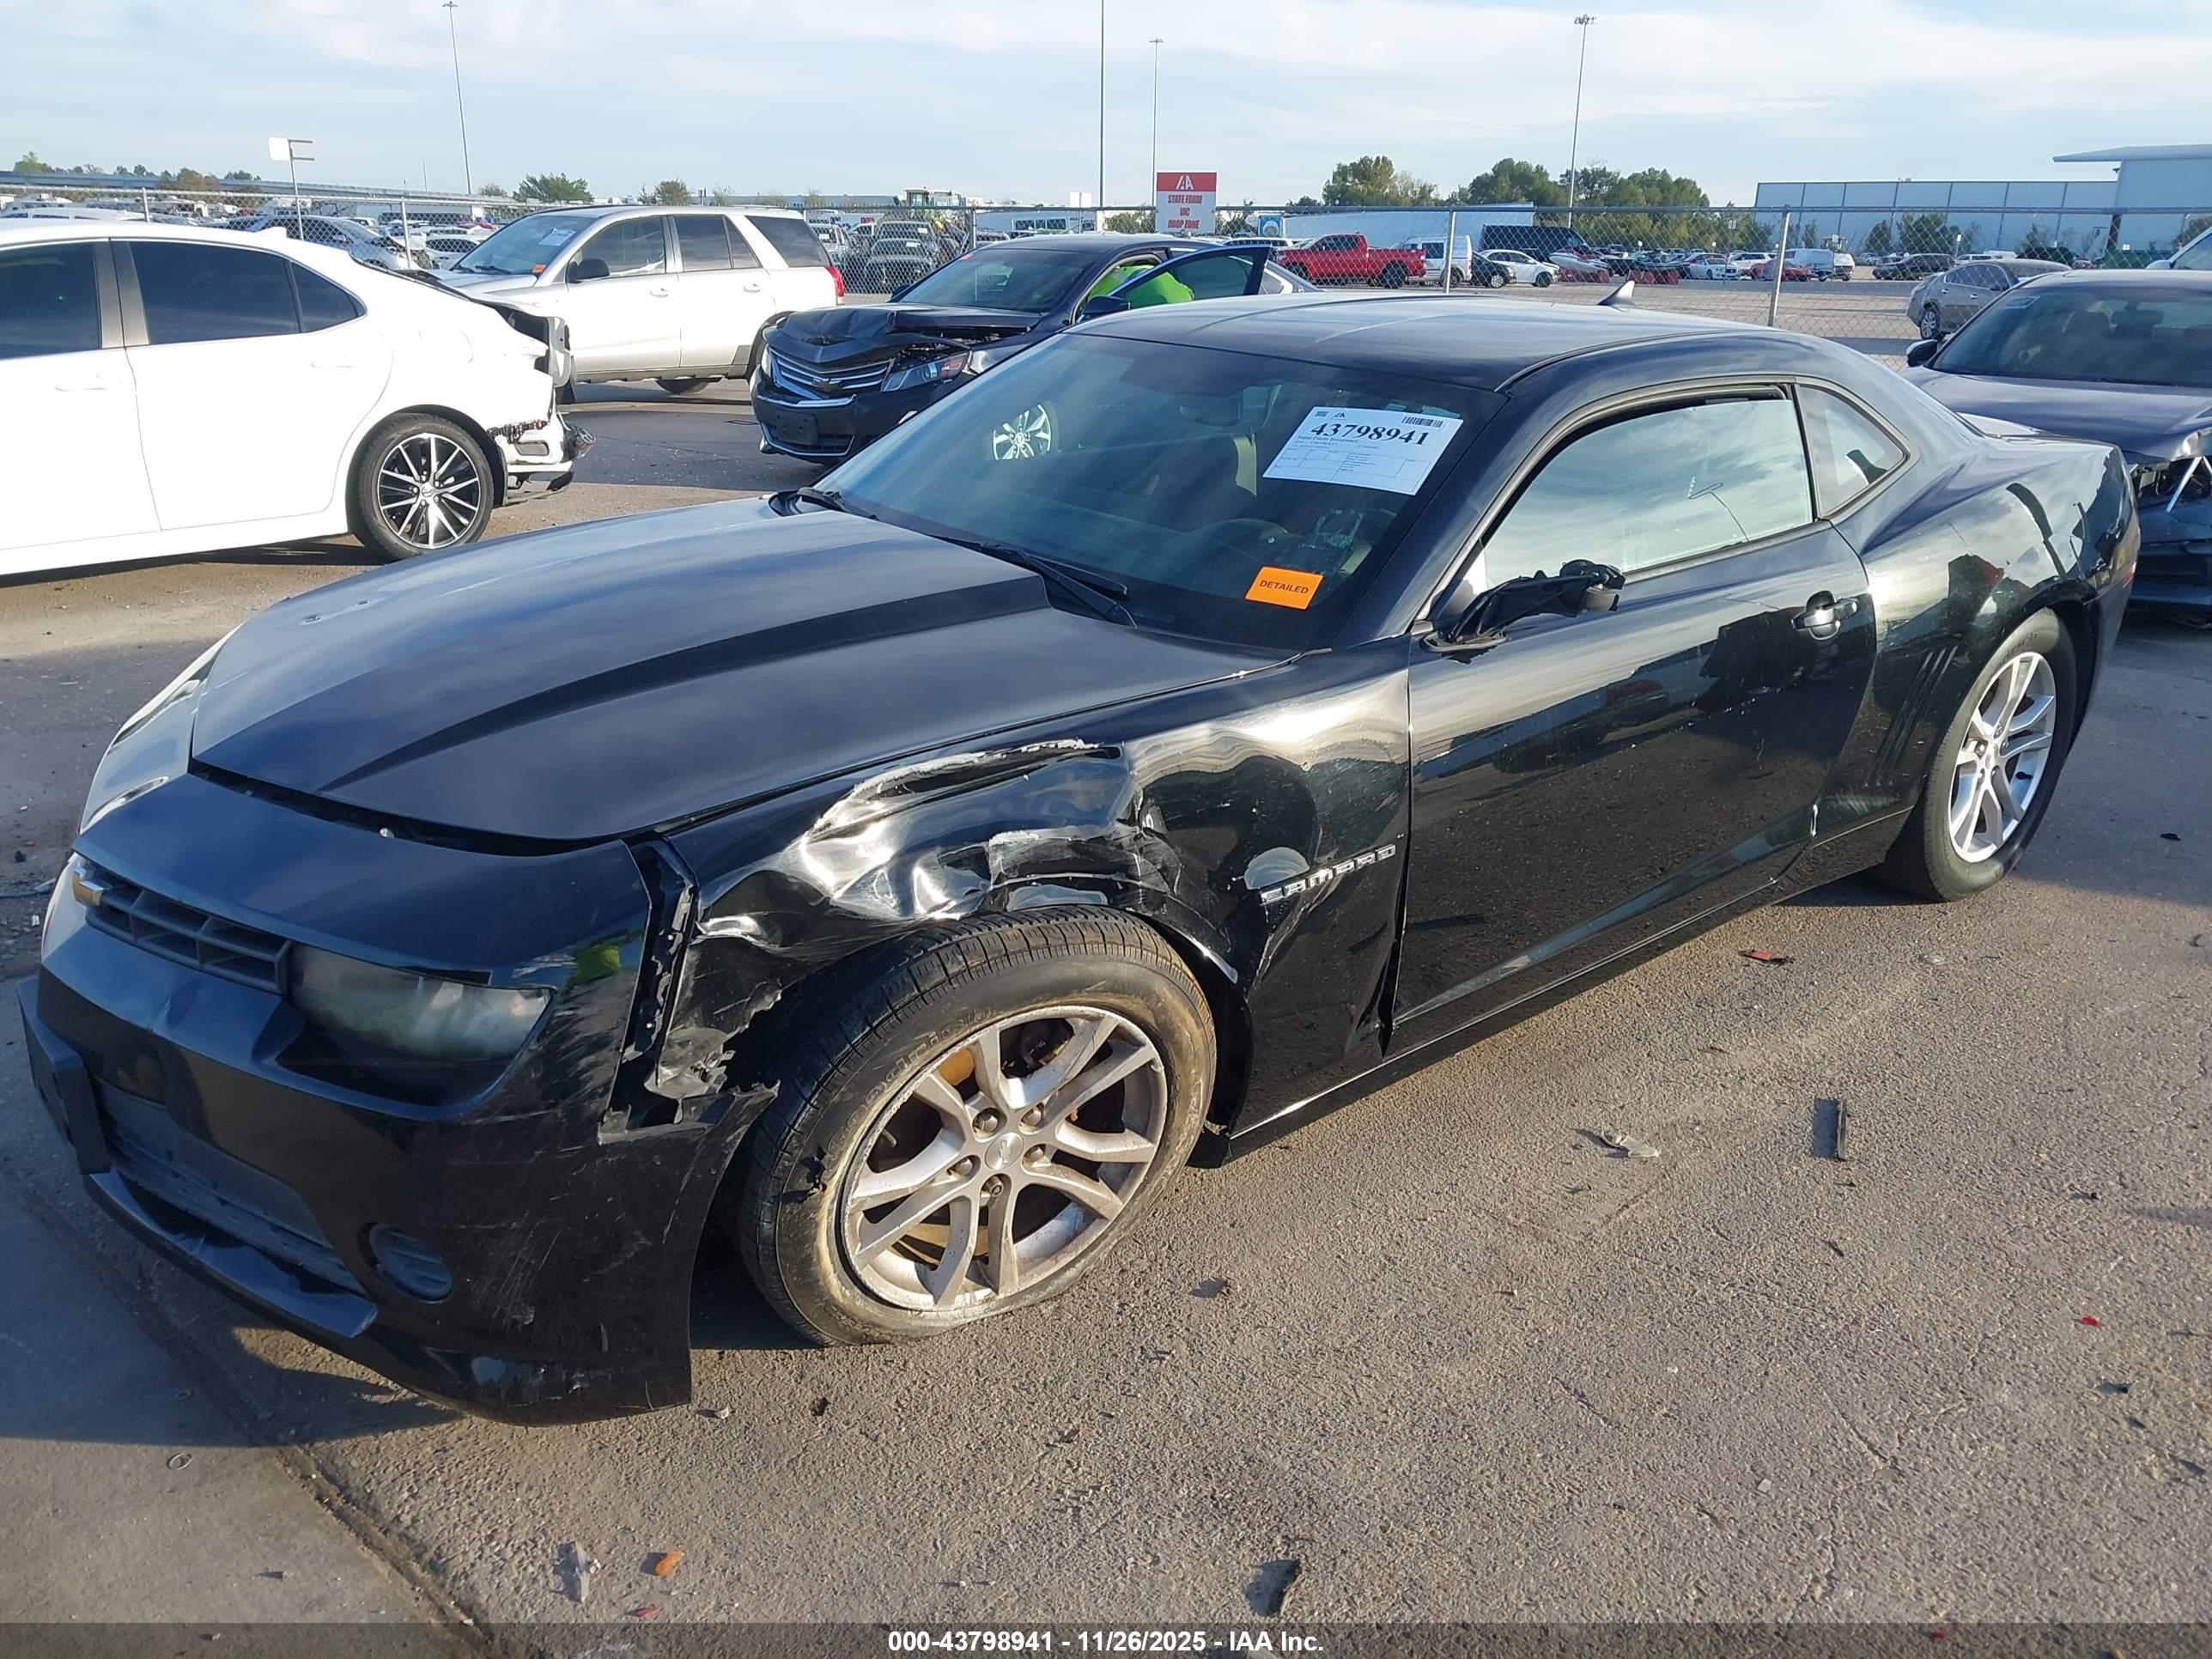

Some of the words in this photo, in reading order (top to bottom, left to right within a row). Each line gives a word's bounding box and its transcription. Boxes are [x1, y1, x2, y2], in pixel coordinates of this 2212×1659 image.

[1168, 194, 1185, 204] STATE
[1186, 195, 1202, 204] FARM
[1168, 219, 1184, 228] DROP
[1185, 220, 1200, 229] ZONE
[1311, 422, 1429, 446] 43798941
[1260, 580, 1309, 594] DETAILED
[1260, 843, 1396, 907] CAMARO
